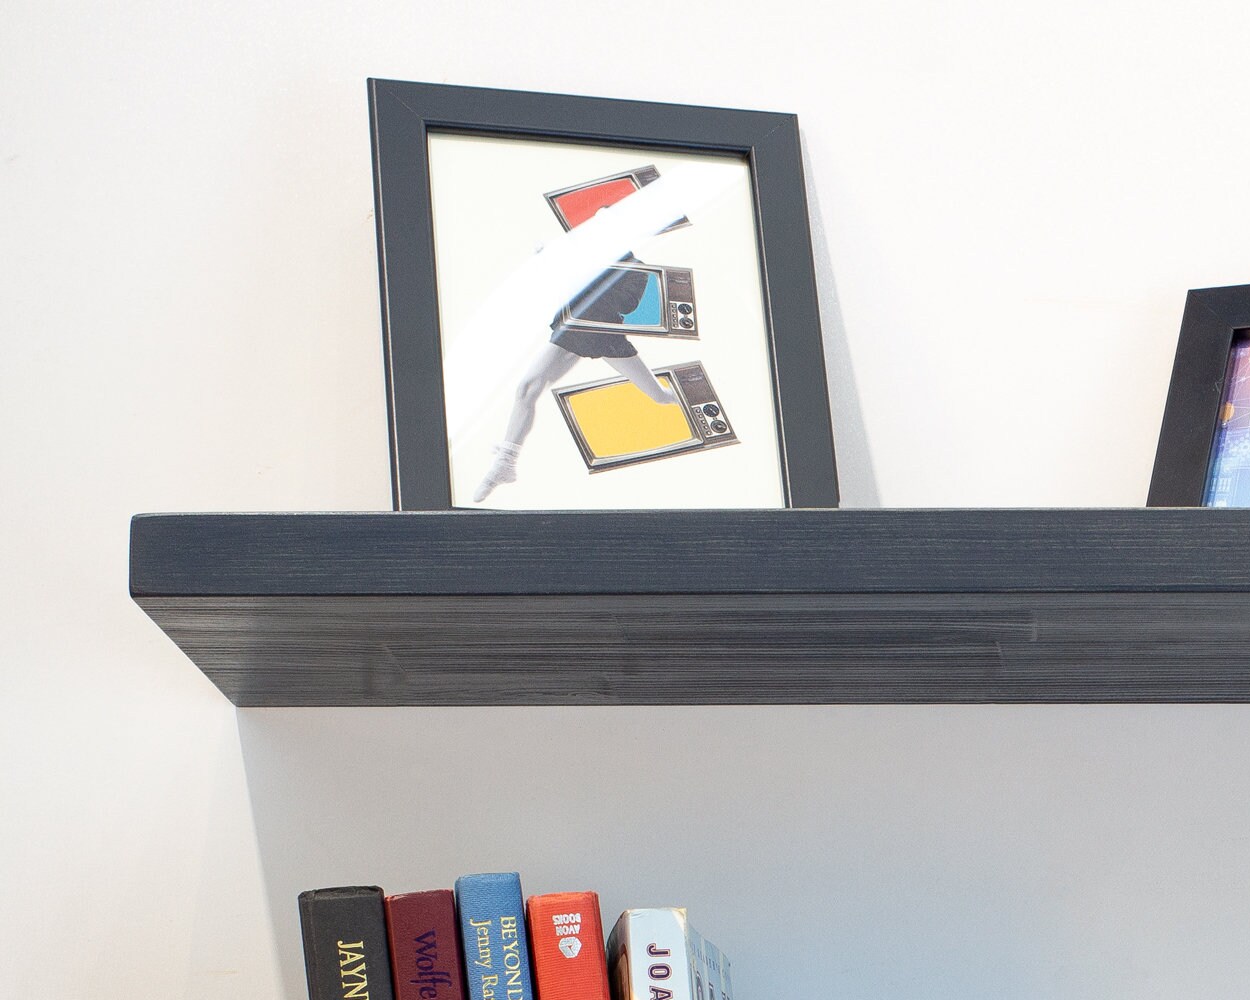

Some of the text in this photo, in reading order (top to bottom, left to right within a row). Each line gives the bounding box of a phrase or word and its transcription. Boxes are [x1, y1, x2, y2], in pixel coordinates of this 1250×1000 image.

[470, 918, 492, 969] Jenny
[555, 924, 581, 936] AVON
[410, 927, 452, 1000] Wolfe
